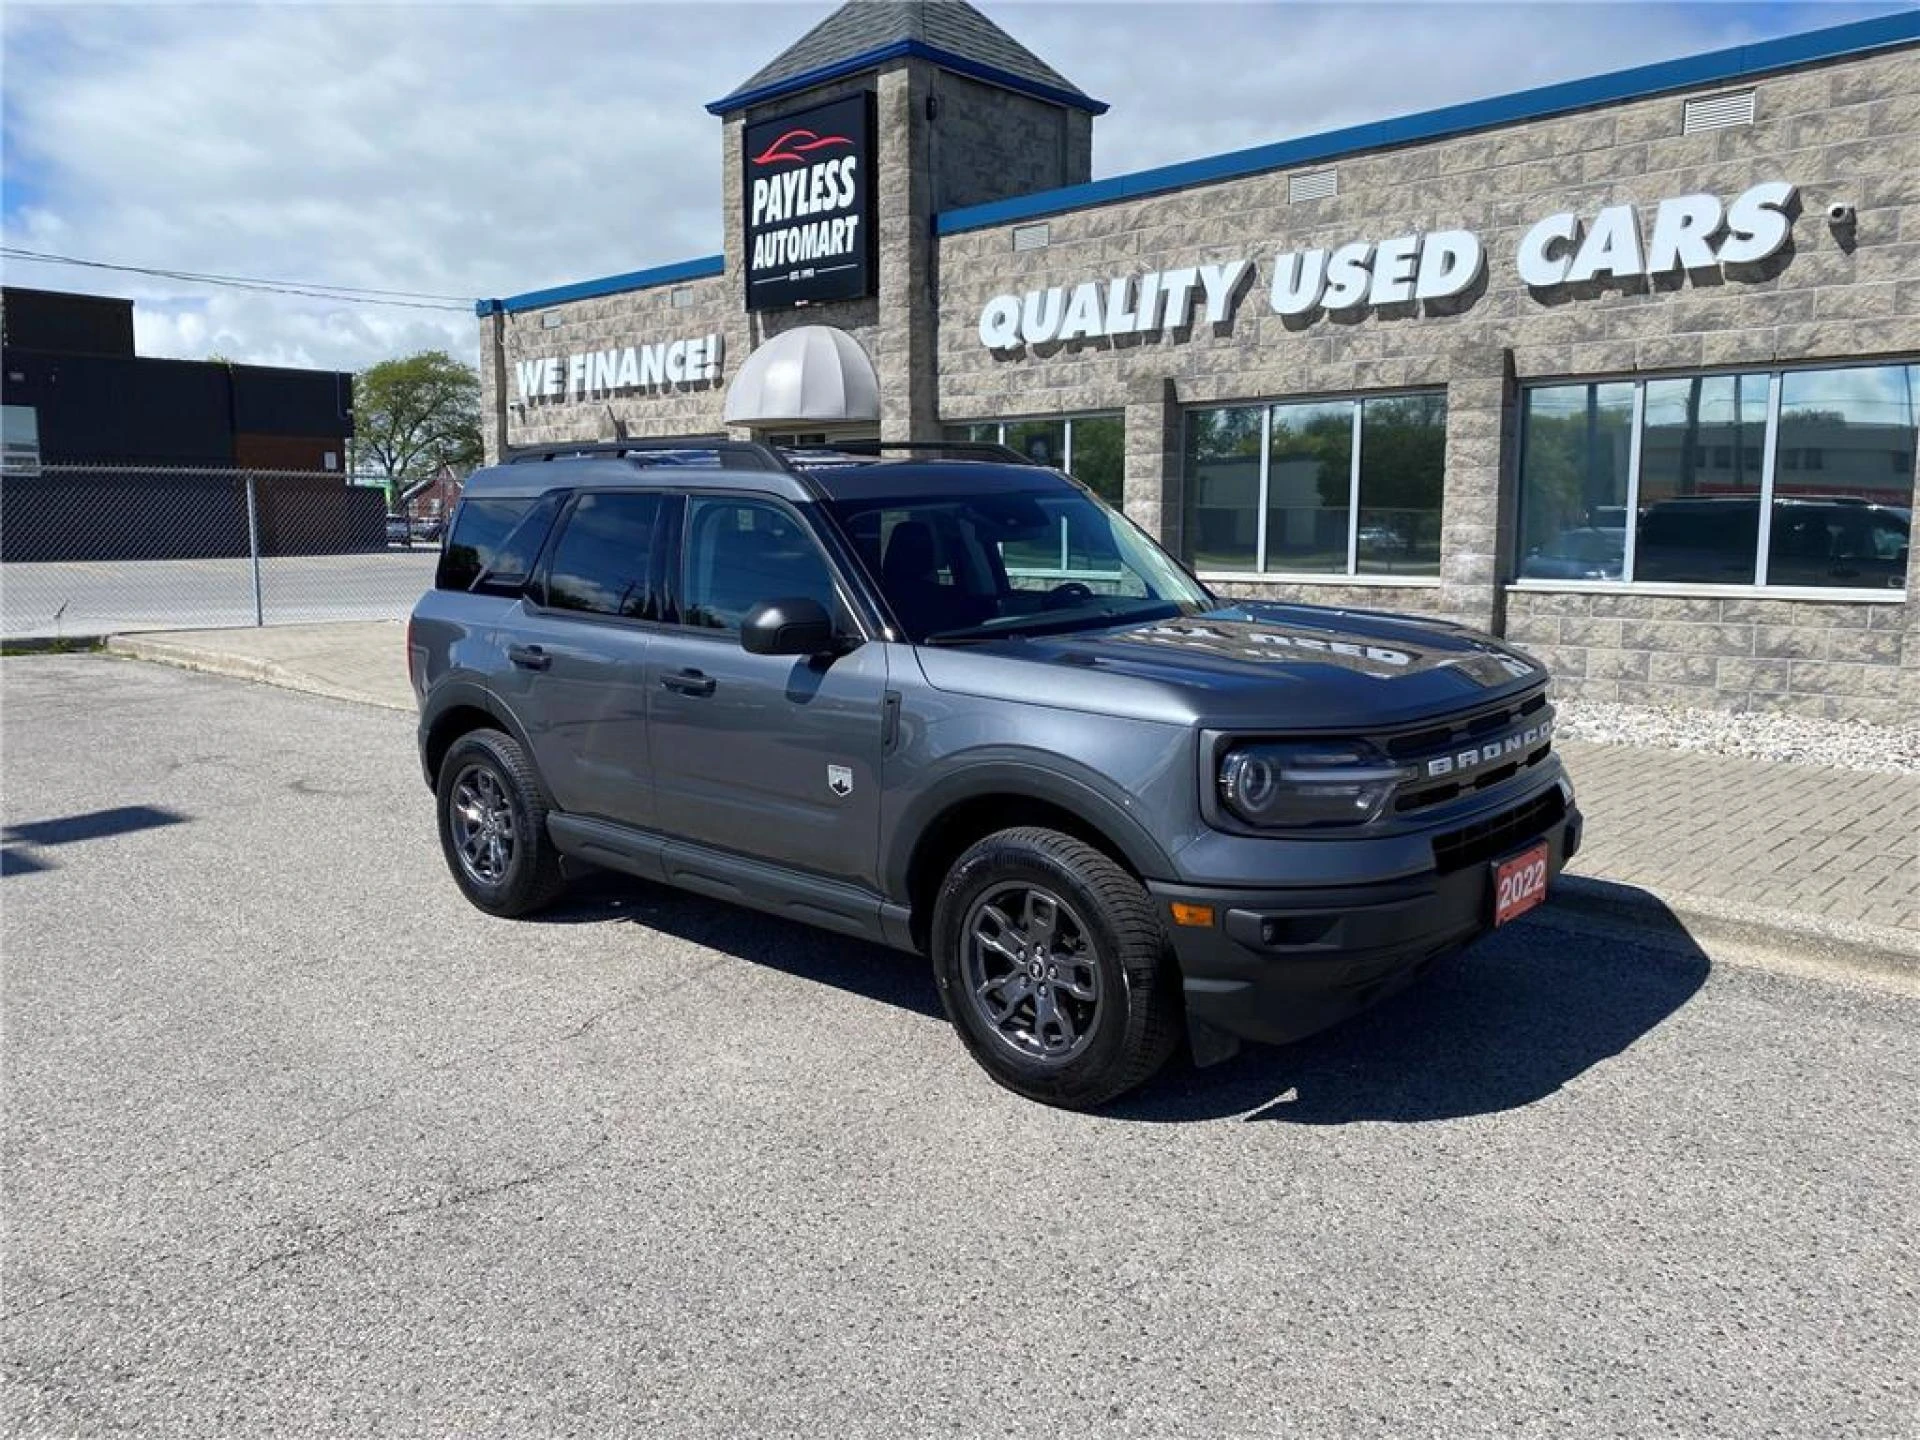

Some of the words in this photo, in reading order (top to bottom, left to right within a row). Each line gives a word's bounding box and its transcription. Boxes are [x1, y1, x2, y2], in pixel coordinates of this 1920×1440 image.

[752, 155, 857, 226] PAYLESS
[752, 215, 859, 270] AUTOMART
[979, 259, 1250, 350] QUALITY
[1270, 230, 1485, 315] USED
[1517, 181, 1795, 287] CARS
[516, 357, 560, 398] WE
[569, 333, 720, 393] FINANCE!
[1428, 721, 1552, 778] BRONCO
[1500, 860, 1546, 909] 2022
